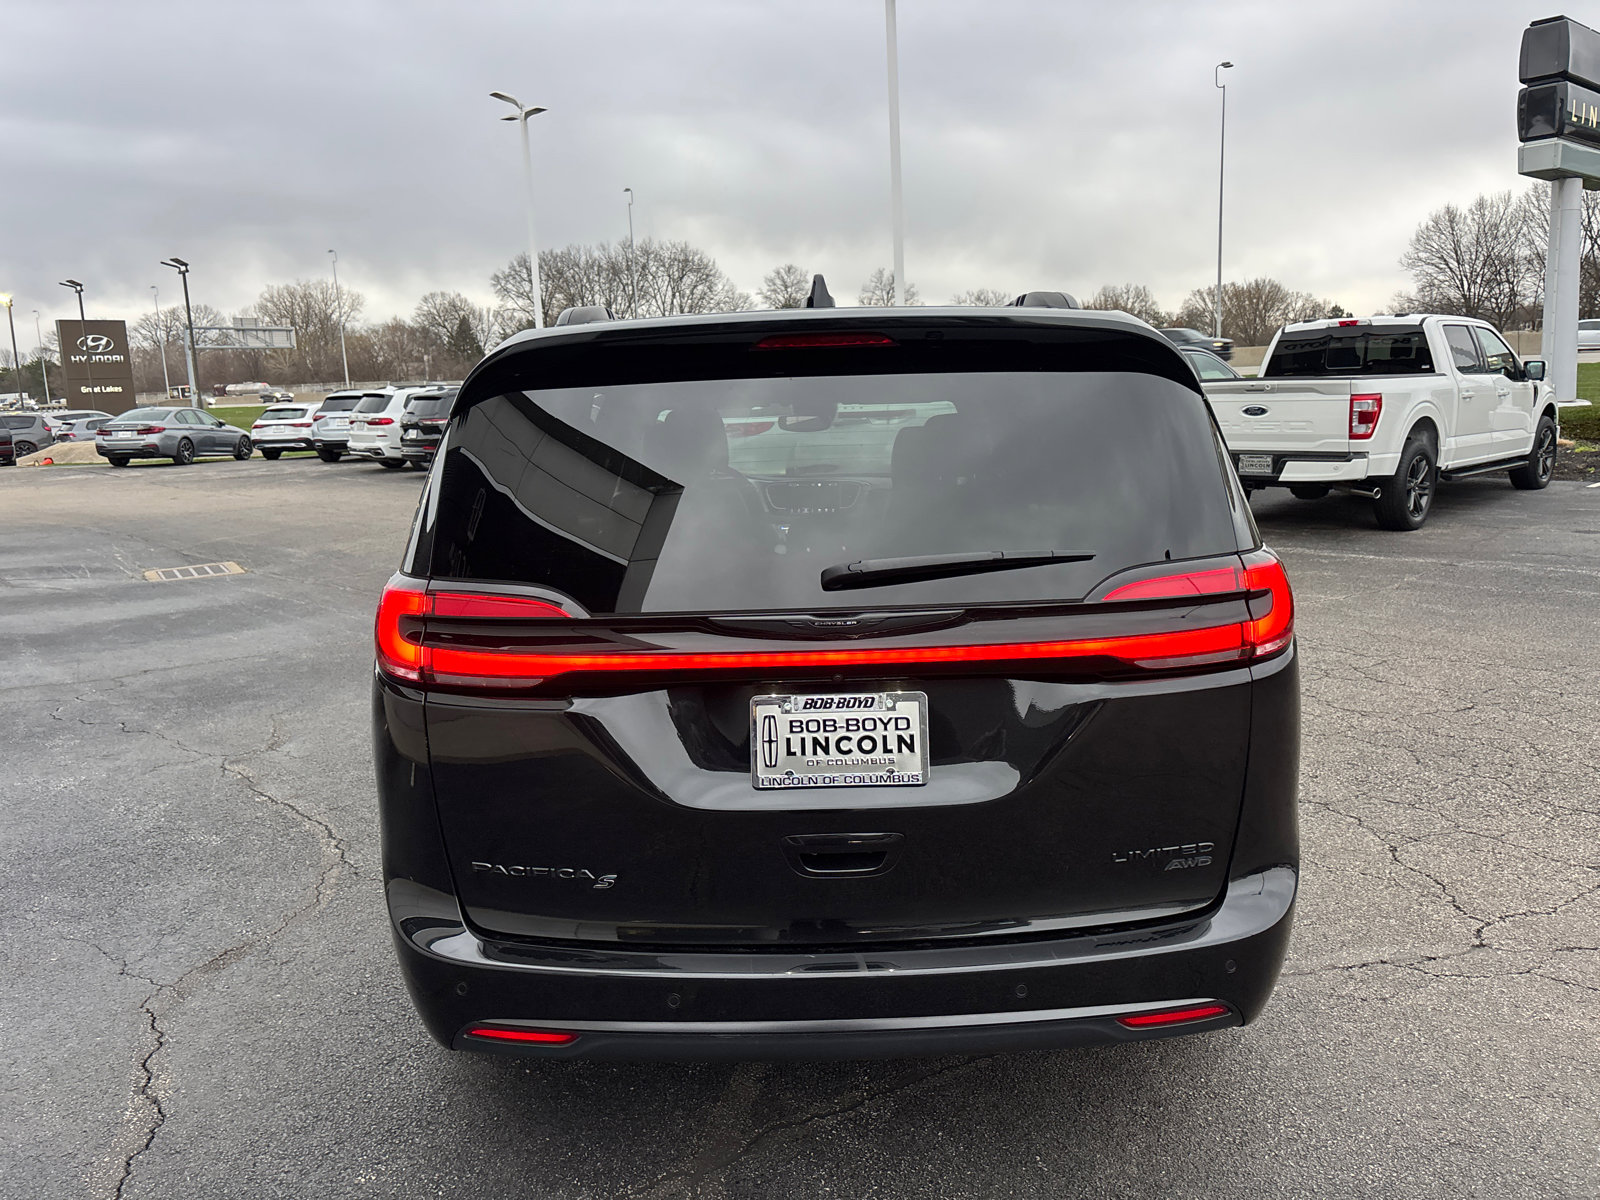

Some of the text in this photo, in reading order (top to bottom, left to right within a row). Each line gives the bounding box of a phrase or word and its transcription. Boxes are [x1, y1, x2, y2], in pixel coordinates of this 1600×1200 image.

[1571, 99, 1598, 129] LIN
[71, 355, 124, 363] HYUNDAI
[102, 385, 122, 393] Lakes
[789, 716, 911, 734] BOB-BOYD
[785, 734, 915, 757] LINCOLN
[806, 757, 896, 767] OF COLUMBUS
[761, 773, 920, 787] LINCOLN OF COLUMBUS
[1112, 842, 1215, 863] LIMITED
[1164, 855, 1213, 872] AWD
[471, 861, 618, 889] PACIFICA S
